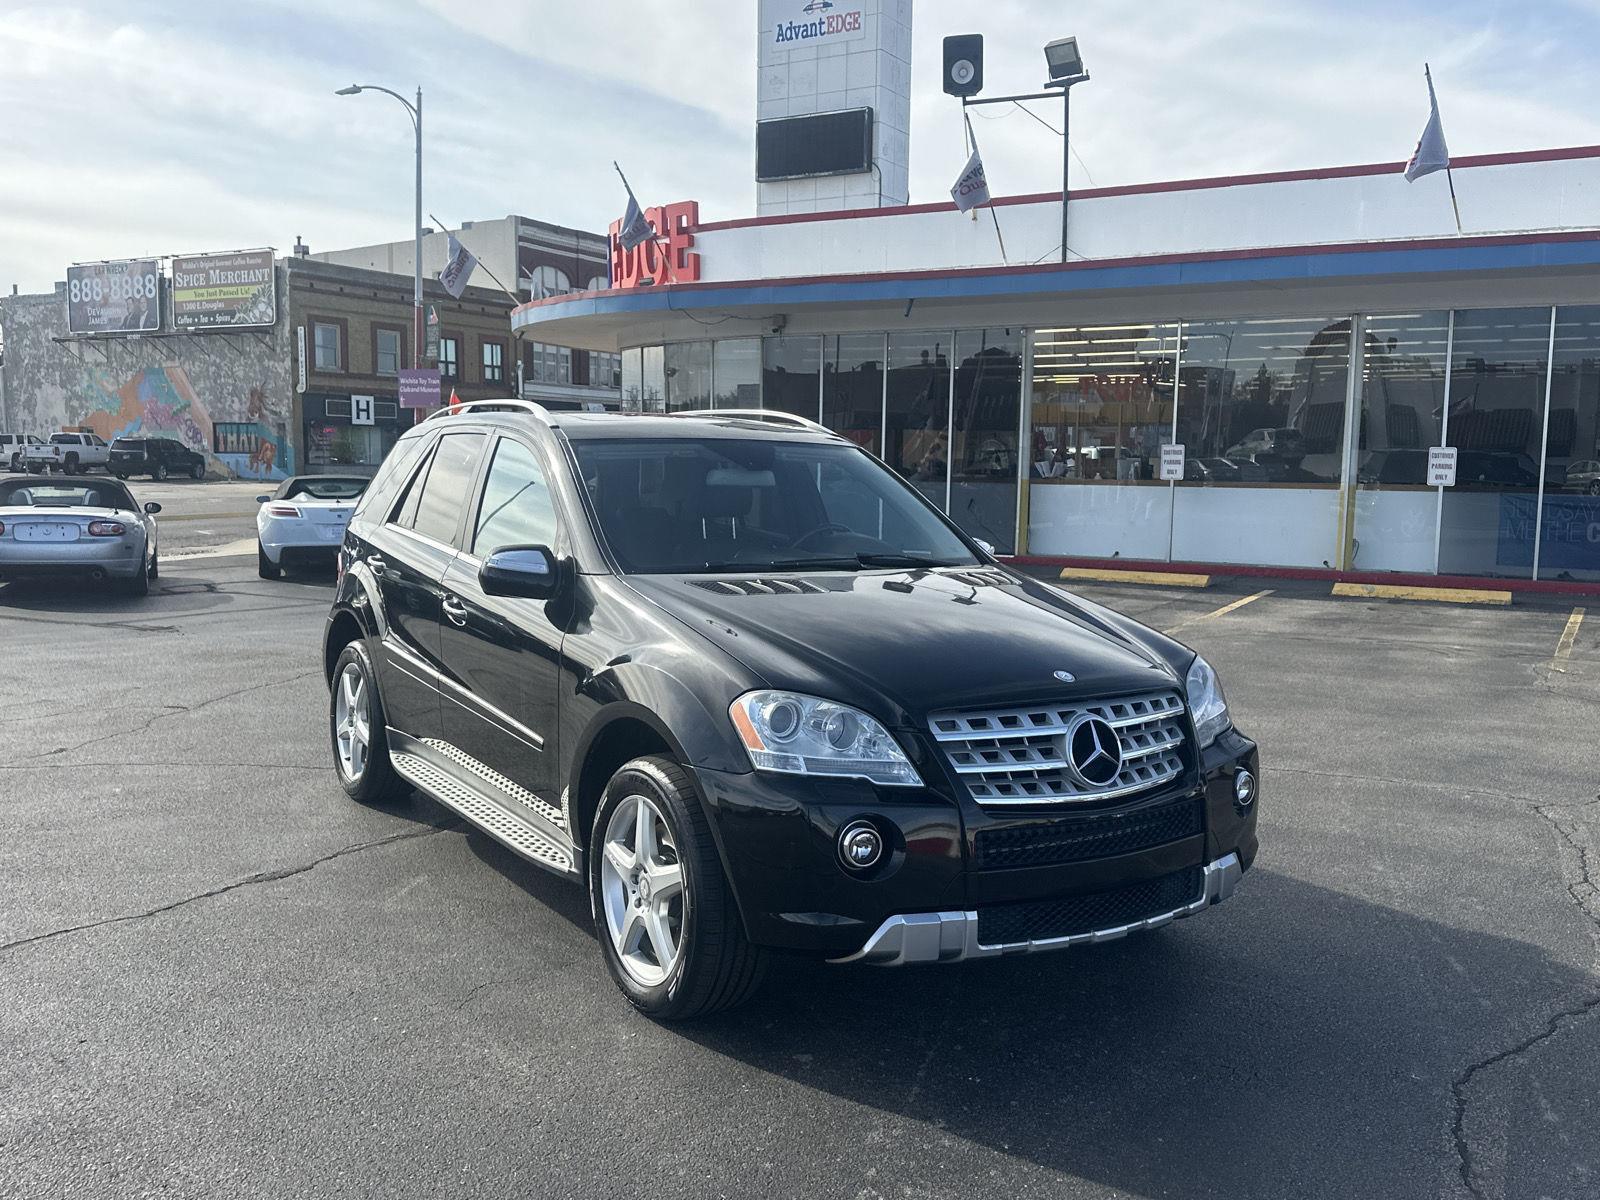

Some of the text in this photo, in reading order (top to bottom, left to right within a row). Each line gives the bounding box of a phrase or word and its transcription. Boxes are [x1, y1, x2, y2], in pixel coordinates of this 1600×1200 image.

[775, 11, 861, 42] AdvantEDGE
[608, 200, 700, 289] EDGE
[70, 273, 156, 303] 888-8888
[175, 268, 270, 288] SPICE MERCHANT
[193, 290, 205, 298] You
[206, 289, 217, 298] Just
[218, 287, 238, 297] Passed
[202, 300, 225, 310] Douglas
[177, 313, 231, 324] Coffee Tea Spices
[418, 377, 427, 385] Toy
[355, 399, 370, 420] H
